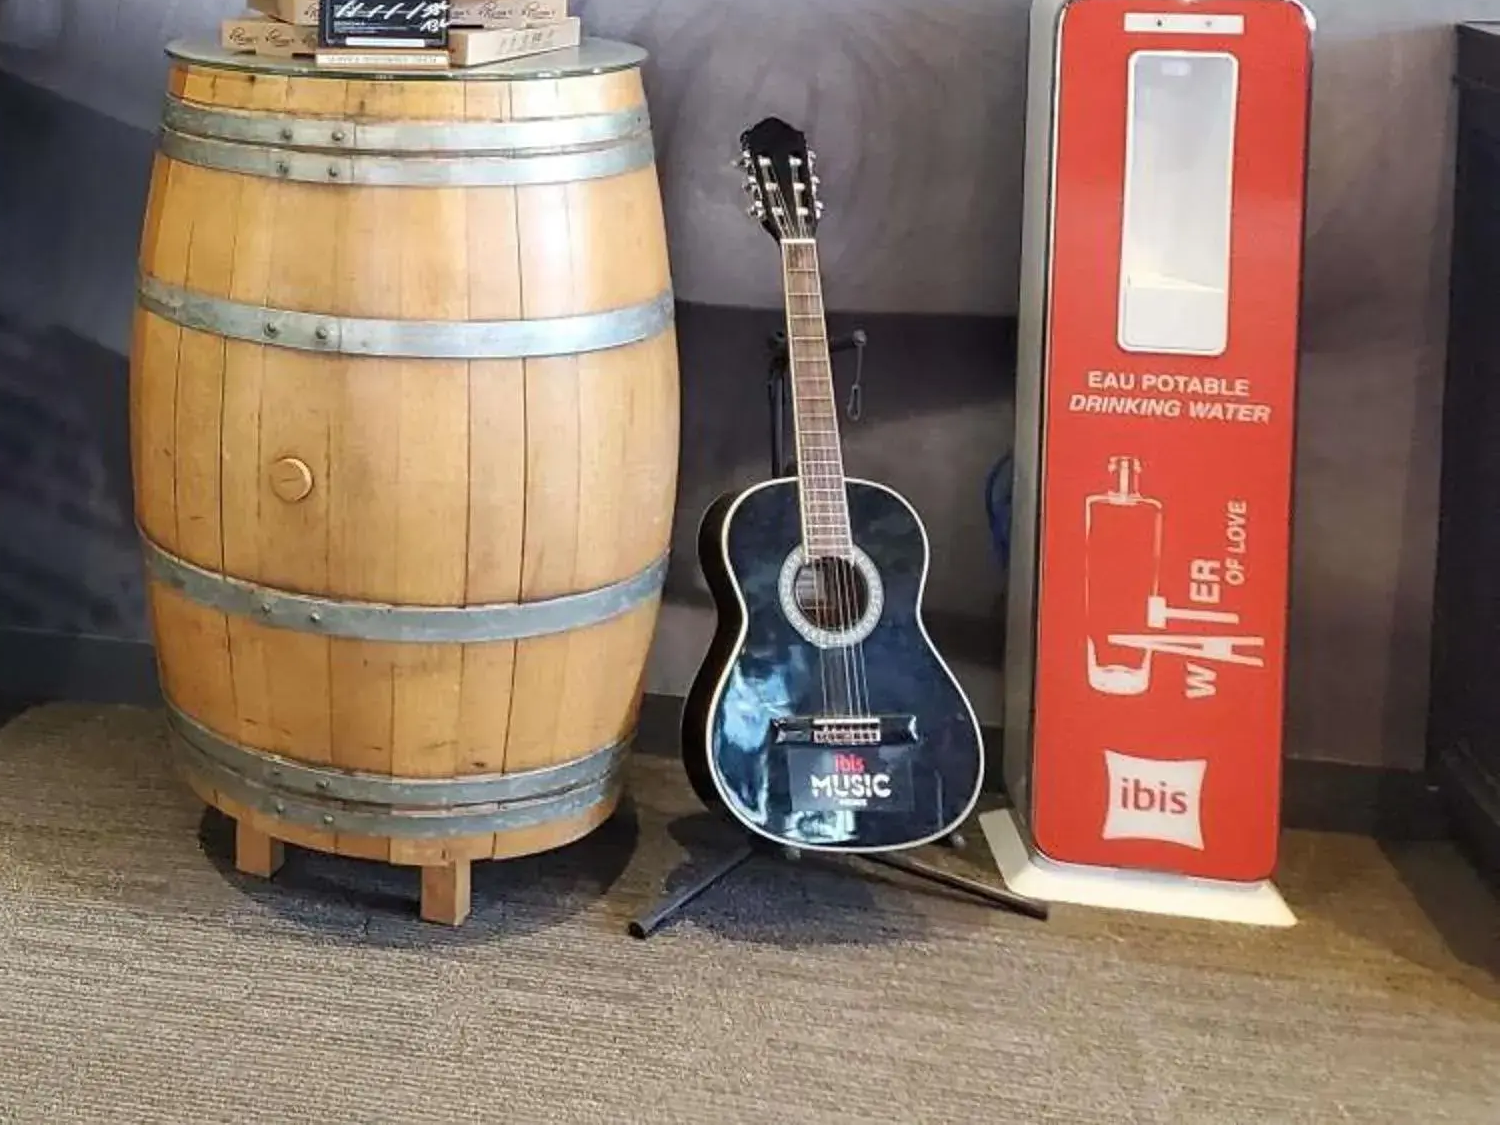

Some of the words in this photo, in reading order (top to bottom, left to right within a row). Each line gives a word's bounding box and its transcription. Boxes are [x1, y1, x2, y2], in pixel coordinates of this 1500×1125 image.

[1087, 370, 1136, 392] EAU
[1141, 374, 1251, 398] POTABLE
[1068, 393, 1181, 418] DRINKING
[1187, 399, 1273, 424] WATER
[1226, 499, 1249, 551] LOVE
[1225, 556, 1246, 587] OF
[834, 752, 866, 773] ibis
[810, 773, 892, 798] MUSIC
[1119, 776, 1189, 817] ibis
